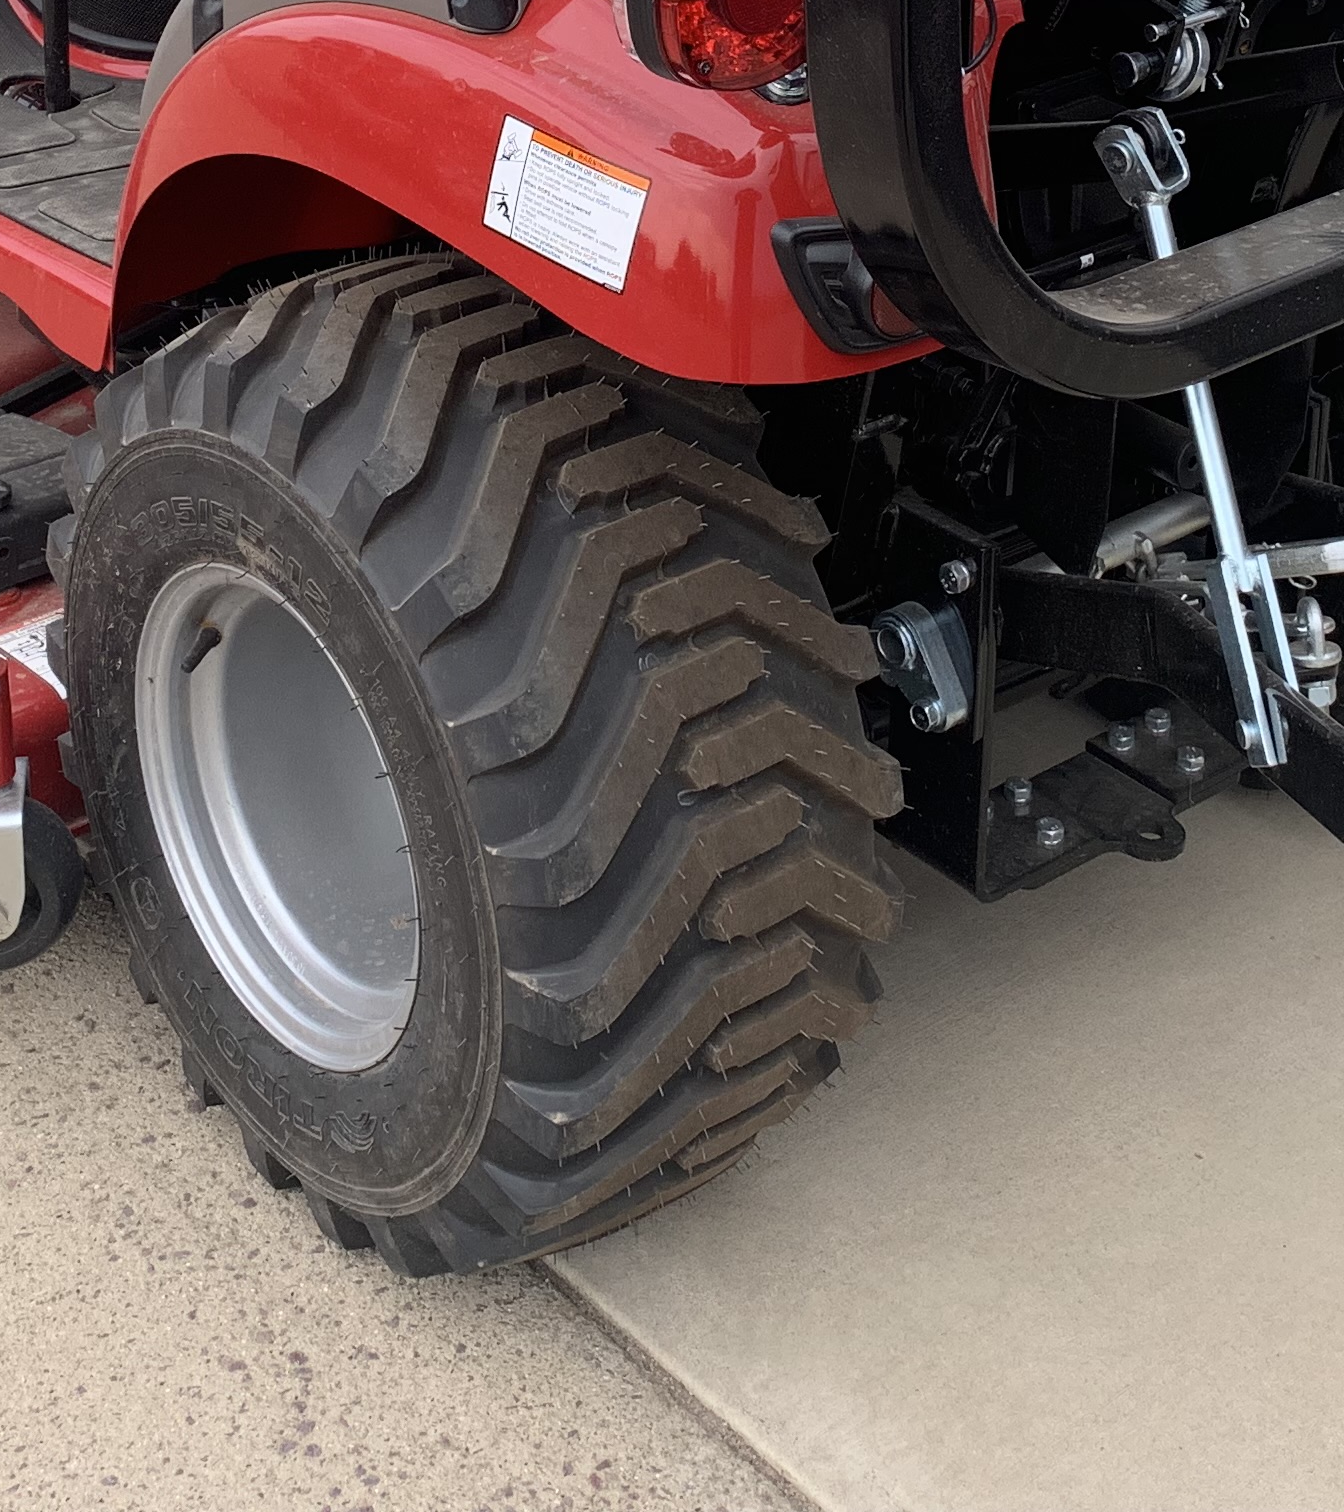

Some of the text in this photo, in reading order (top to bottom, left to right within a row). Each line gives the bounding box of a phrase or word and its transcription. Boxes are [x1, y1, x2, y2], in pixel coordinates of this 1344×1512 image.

[531, 142, 643, 200] TO PREVENT DEATH OR SERIOUS INJURY
[577, 152, 609, 172] WARNING
